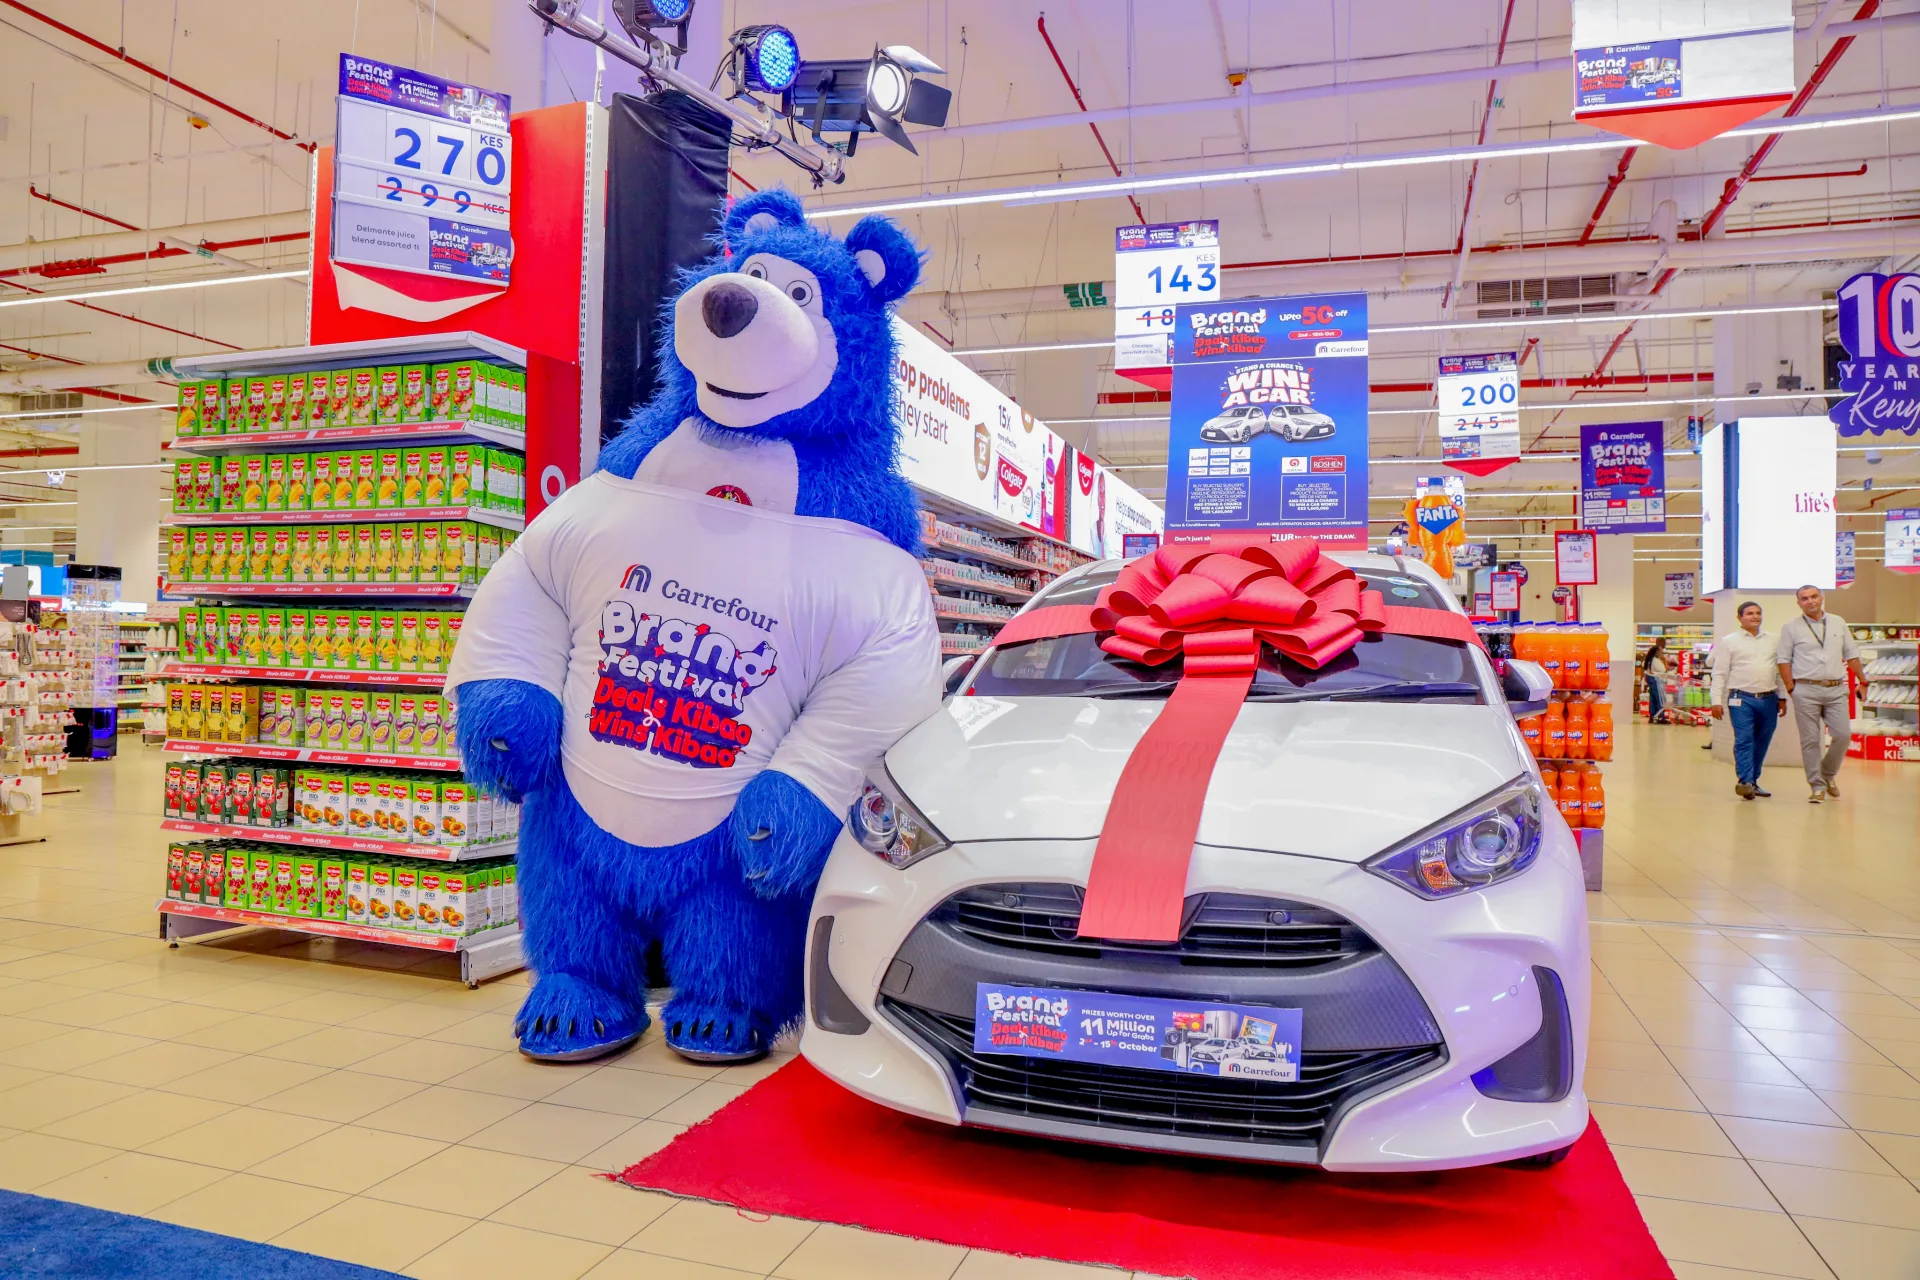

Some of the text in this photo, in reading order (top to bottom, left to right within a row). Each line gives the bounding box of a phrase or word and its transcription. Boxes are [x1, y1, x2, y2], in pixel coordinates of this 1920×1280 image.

[345, 58, 393, 80] Brand
[1578, 57, 1626, 72] Brand
[1582, 67, 1622, 78] Festival
[349, 70, 389, 86] Festival
[399, 84, 439, 97] 11 Million
[419, 100, 440, 108] October
[480, 134, 503, 149] KES
[394, 127, 506, 185] 270
[386, 176, 504, 215] 299 KES
[356, 224, 415, 240] Delmonte juice
[430, 230, 469, 244] Brand
[461, 226, 488, 235] Carrefour
[1119, 227, 1147, 237] Brand
[352, 235, 411, 249] blend assorted
[432, 240, 465, 250] Festival
[1196, 254, 1216, 262] KES
[1148, 263, 1216, 294] 143
[1142, 309, 1174, 327] 18
[1189, 307, 1268, 329] Brand
[1336, 309, 1348, 318] off
[1840, 276, 1920, 358] 10
[1195, 323, 1260, 337] Festival
[1195, 333, 1267, 348] Deals Kibao
[1195, 343, 1263, 358] Wins Kibao
[1236, 364, 1258, 374] STAND
[1842, 364, 1920, 378] YEAR
[1227, 369, 1311, 392] WIN!
[1894, 381, 1907, 390] IN
[898, 358, 970, 420] op problems
[1461, 383, 1516, 406] 200
[1222, 388, 1312, 409] A CAR
[1850, 381, 1920, 431] Keny
[900, 391, 948, 444] hey start
[1457, 416, 1499, 431] 245
[1591, 442, 1653, 460] Brand
[1596, 455, 1647, 468] Festival
[1000, 464, 1023, 489] Colgate
[1079, 463, 1092, 478] Colgate
[1416, 505, 1458, 522] FANTA
[662, 579, 778, 633] Carrefour
[601, 601, 777, 689] Brand
[601, 646, 744, 711] Festival
[594, 676, 752, 745] Deals Kibao
[590, 709, 736, 768] Wins Kibao
[1885, 737, 1919, 747] Deals
[986, 993, 1068, 1016] Brand
[993, 1010, 1061, 1027] Festival
[1080, 1018, 1155, 1035] 11 Million
[991, 1023, 1068, 1041] Deals Kibao
[991, 1035, 1062, 1052] Wins Kibao
[1118, 1042, 1157, 1052] October
[1243, 1068, 1290, 1078] Carrefour
